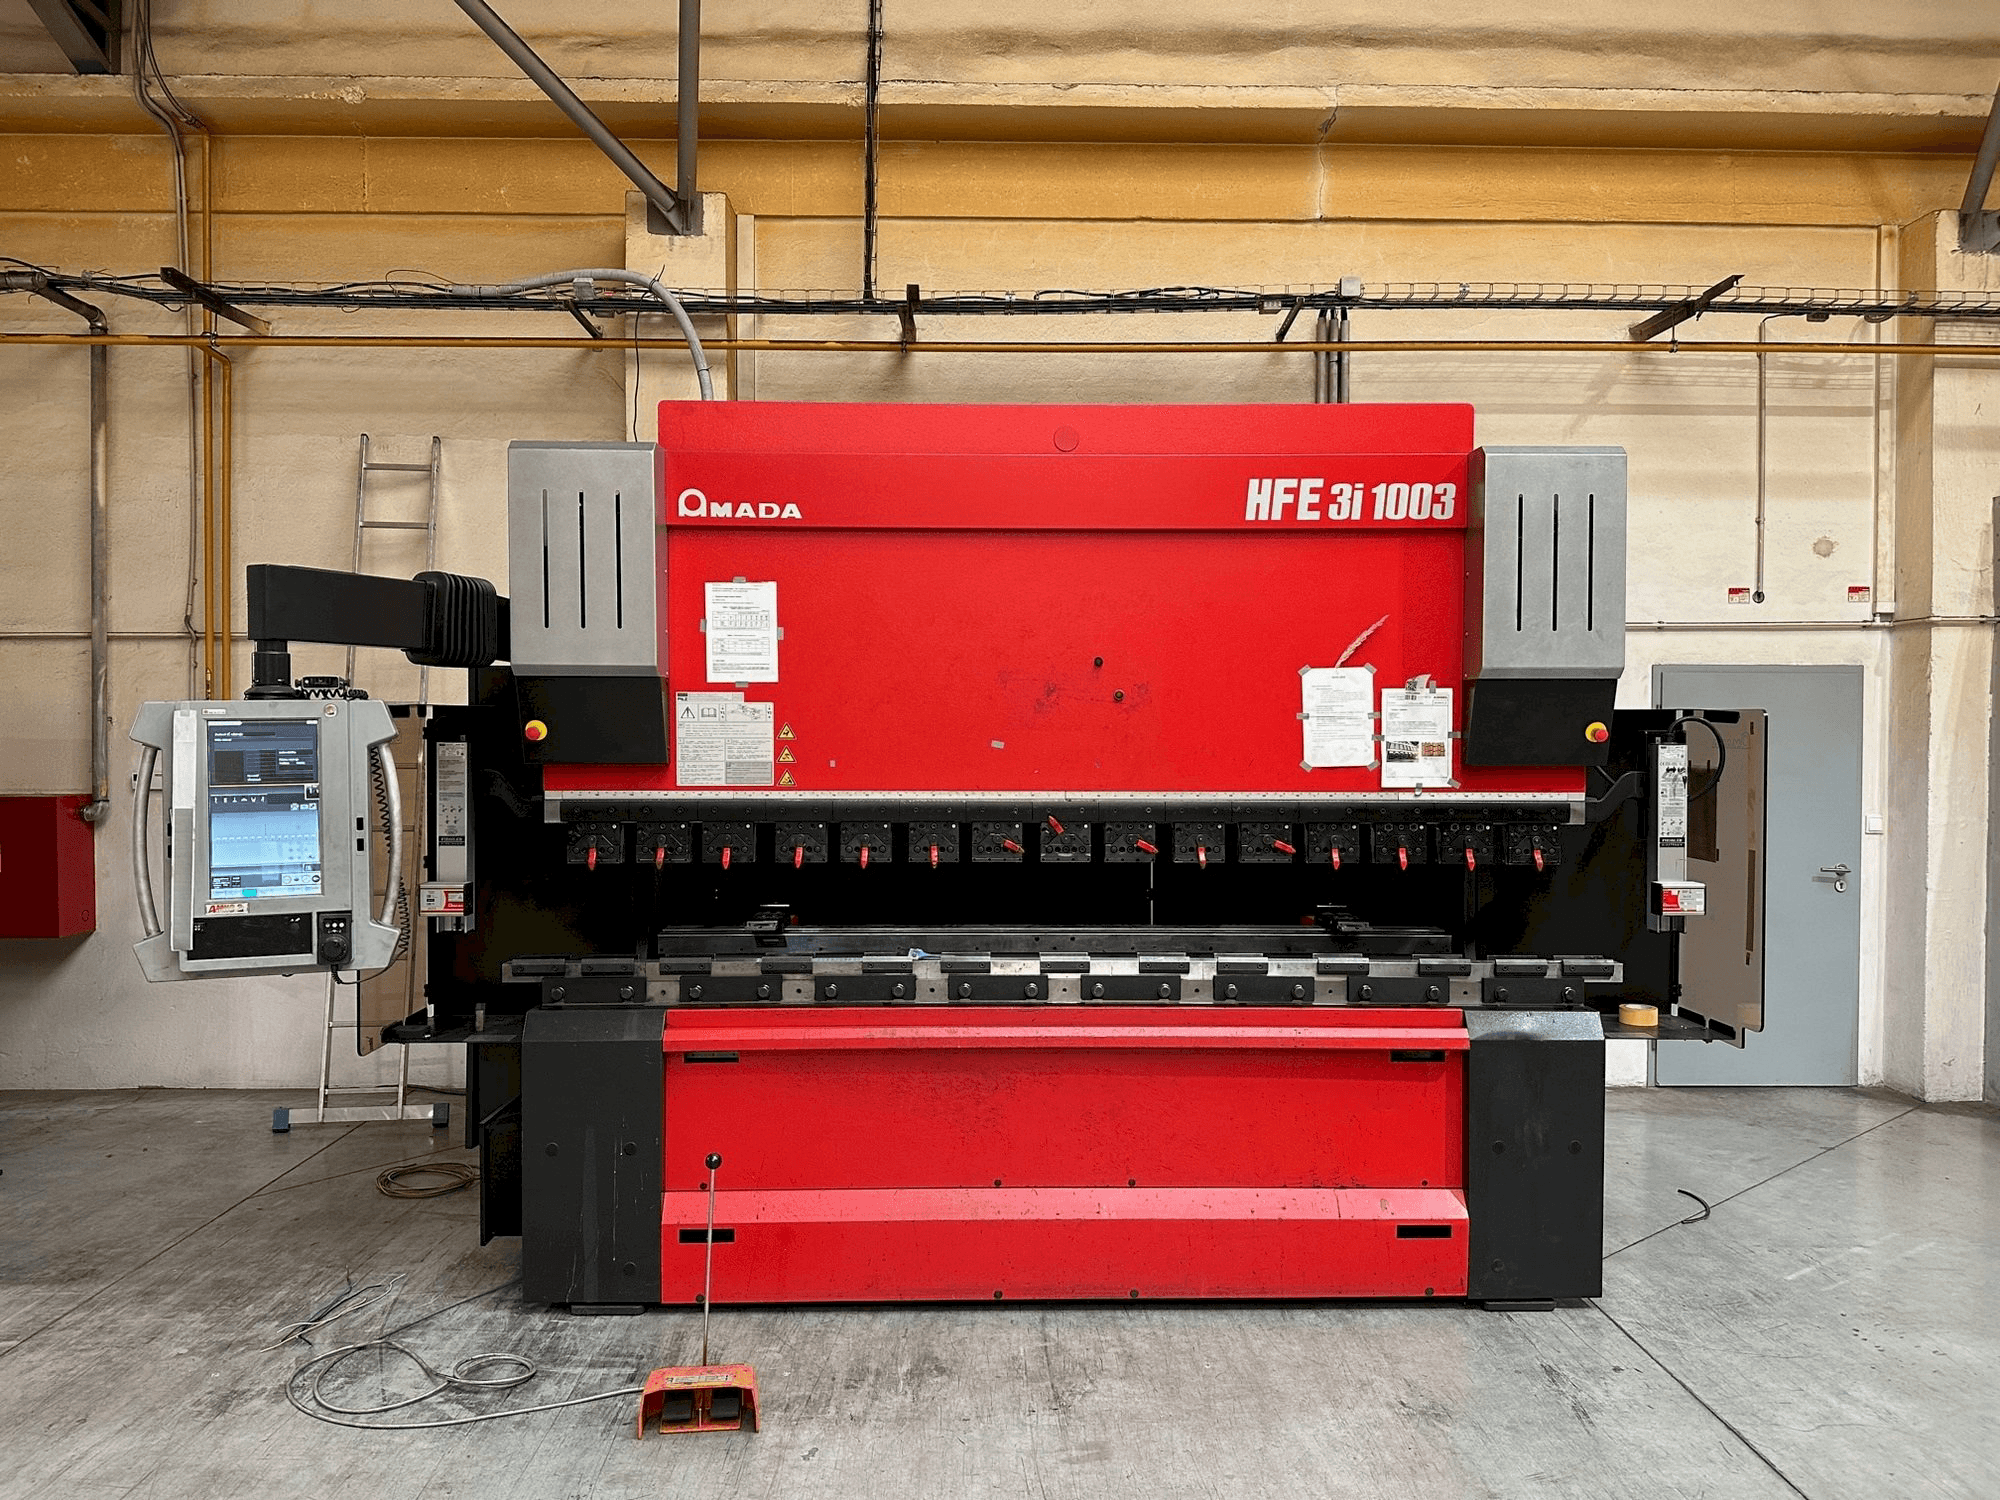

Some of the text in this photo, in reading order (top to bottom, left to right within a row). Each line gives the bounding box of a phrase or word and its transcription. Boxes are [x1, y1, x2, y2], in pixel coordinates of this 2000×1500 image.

[678, 488, 803, 519] AMADA
[1245, 478, 1456, 521] HFE 3i 1003
